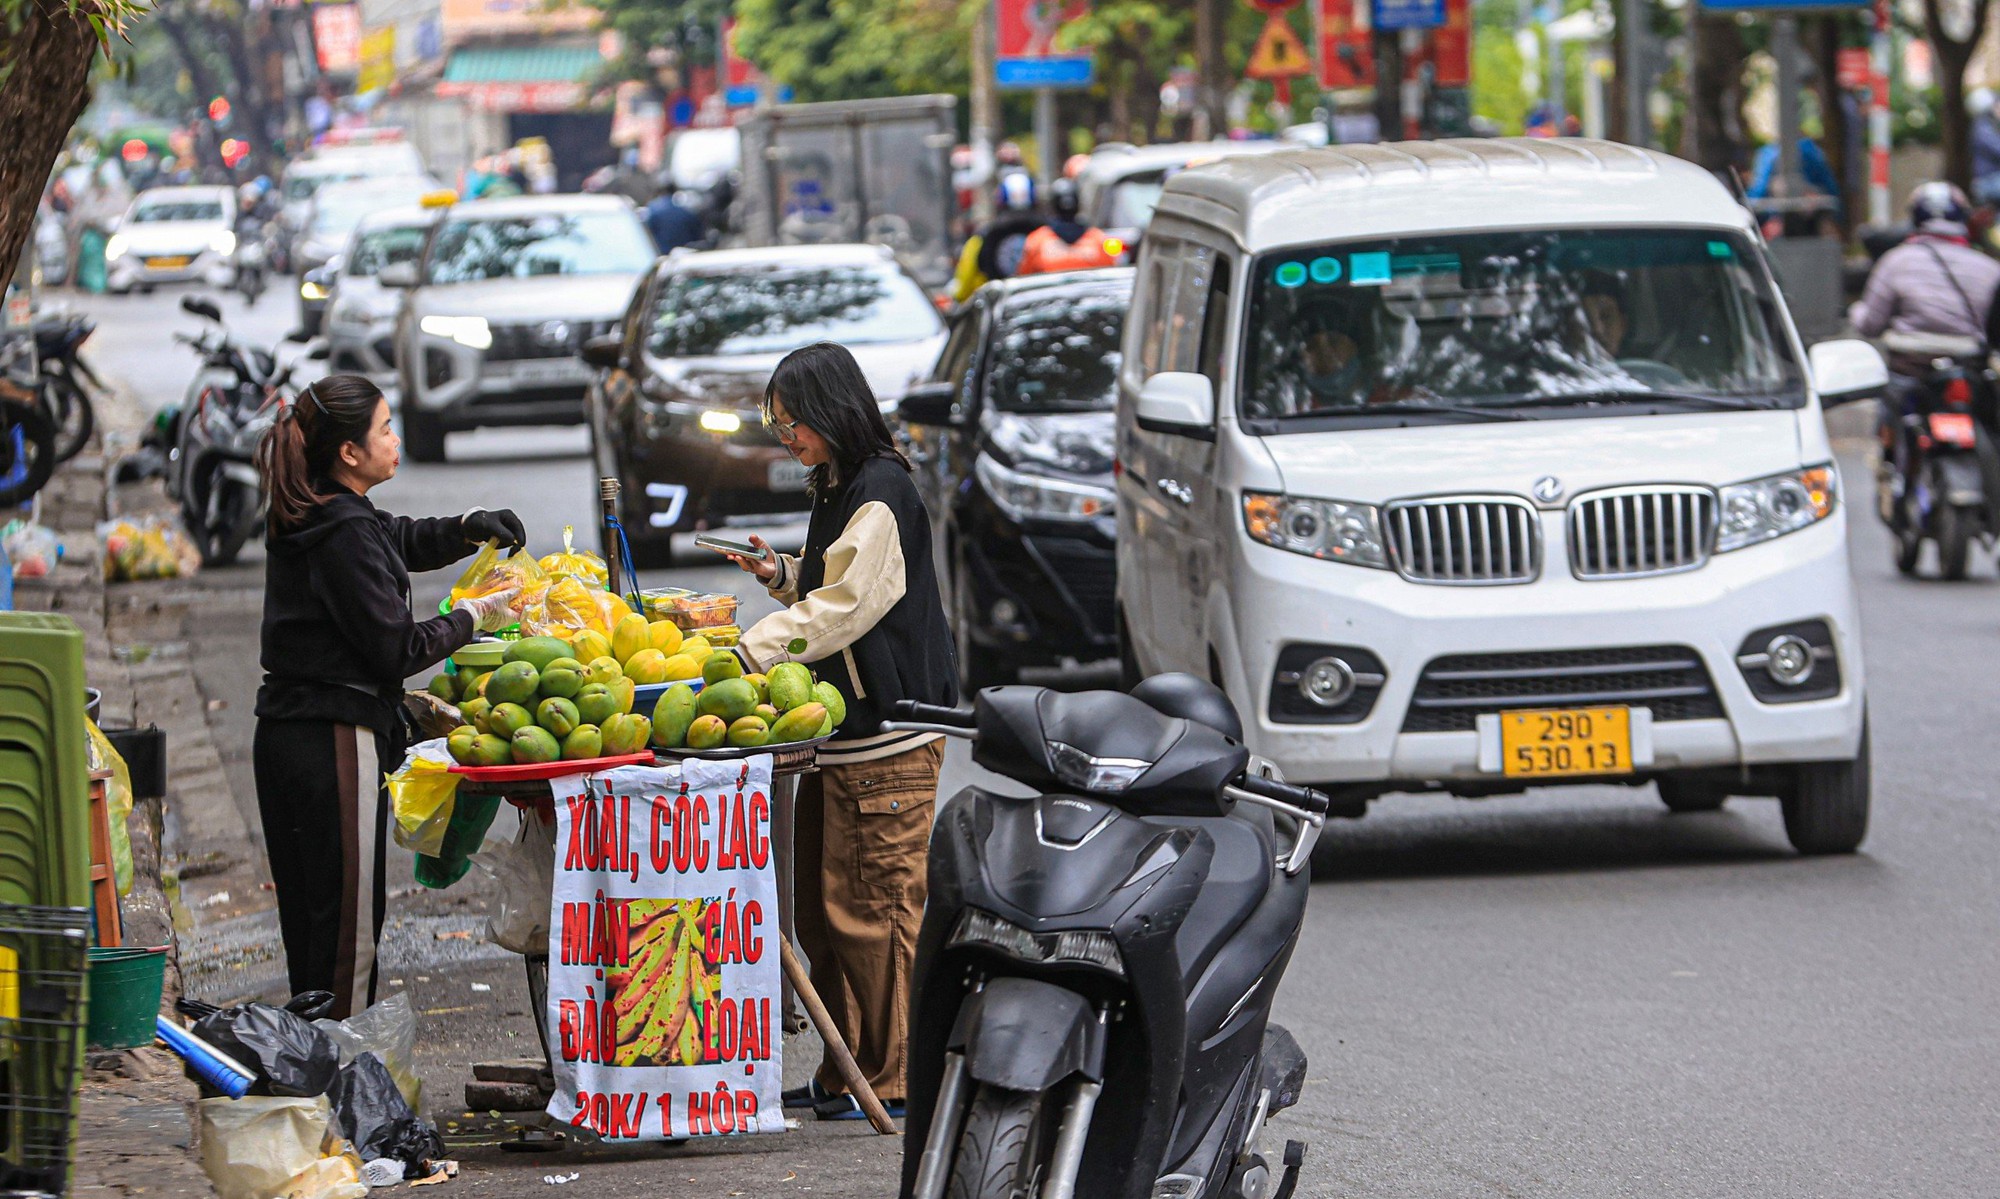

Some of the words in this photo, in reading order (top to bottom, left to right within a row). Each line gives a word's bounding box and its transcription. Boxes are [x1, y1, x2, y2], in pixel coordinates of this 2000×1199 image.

[1517, 742, 1617, 772] 530.13
[564, 778, 639, 883] XOÀI,
[650, 781, 710, 874] CÓC
[717, 763, 769, 871] LÁC
[560, 888, 631, 982] MẬN
[704, 887, 763, 965] CÁC
[559, 985, 618, 1063] ĐÀO
[702, 997, 772, 1076] LOẠI
[571, 1091, 649, 1139] 20K/
[656, 1092, 674, 1137] 1
